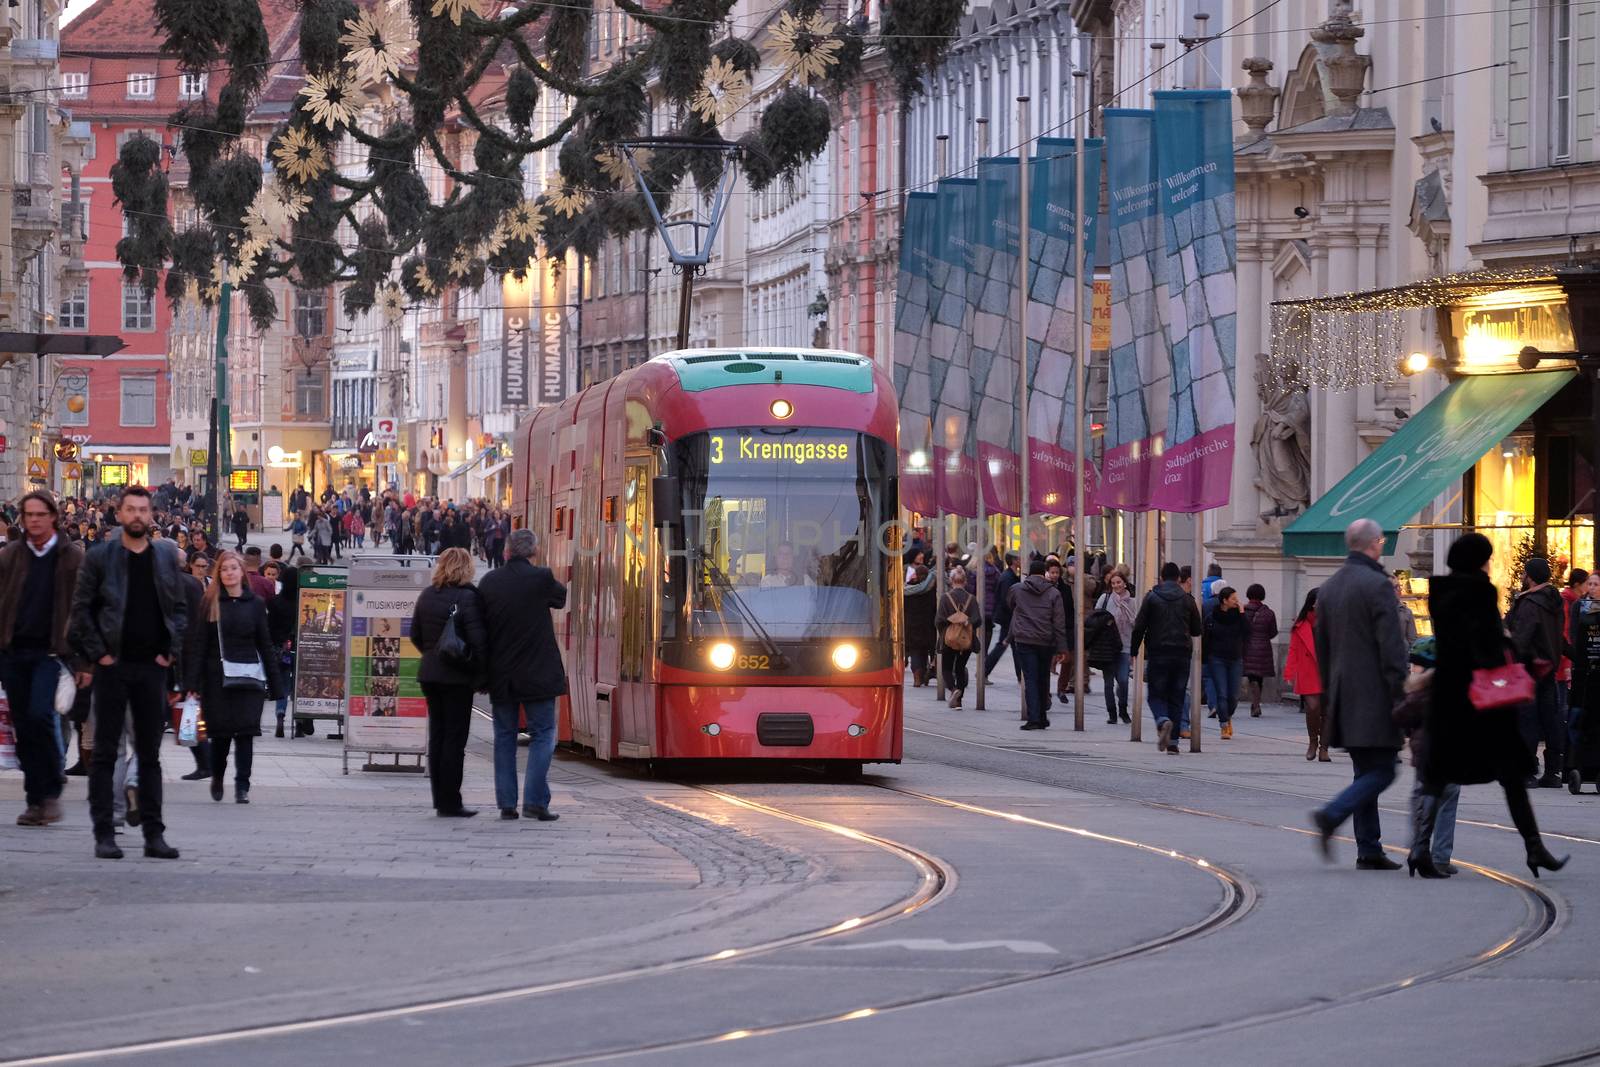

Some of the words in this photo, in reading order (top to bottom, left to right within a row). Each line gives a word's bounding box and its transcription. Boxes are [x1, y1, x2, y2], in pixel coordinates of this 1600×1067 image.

[1166, 161, 1217, 189] Willkommen
[1171, 182, 1199, 203] welcome
[507, 317, 523, 399] HUMANIC
[545, 312, 560, 397] HUMANIC
[711, 437, 724, 463] 3
[740, 437, 848, 464] Krenngasse
[1164, 473, 1182, 485] Graz
[366, 600, 415, 610] musikverein
[738, 655, 770, 670] 652
